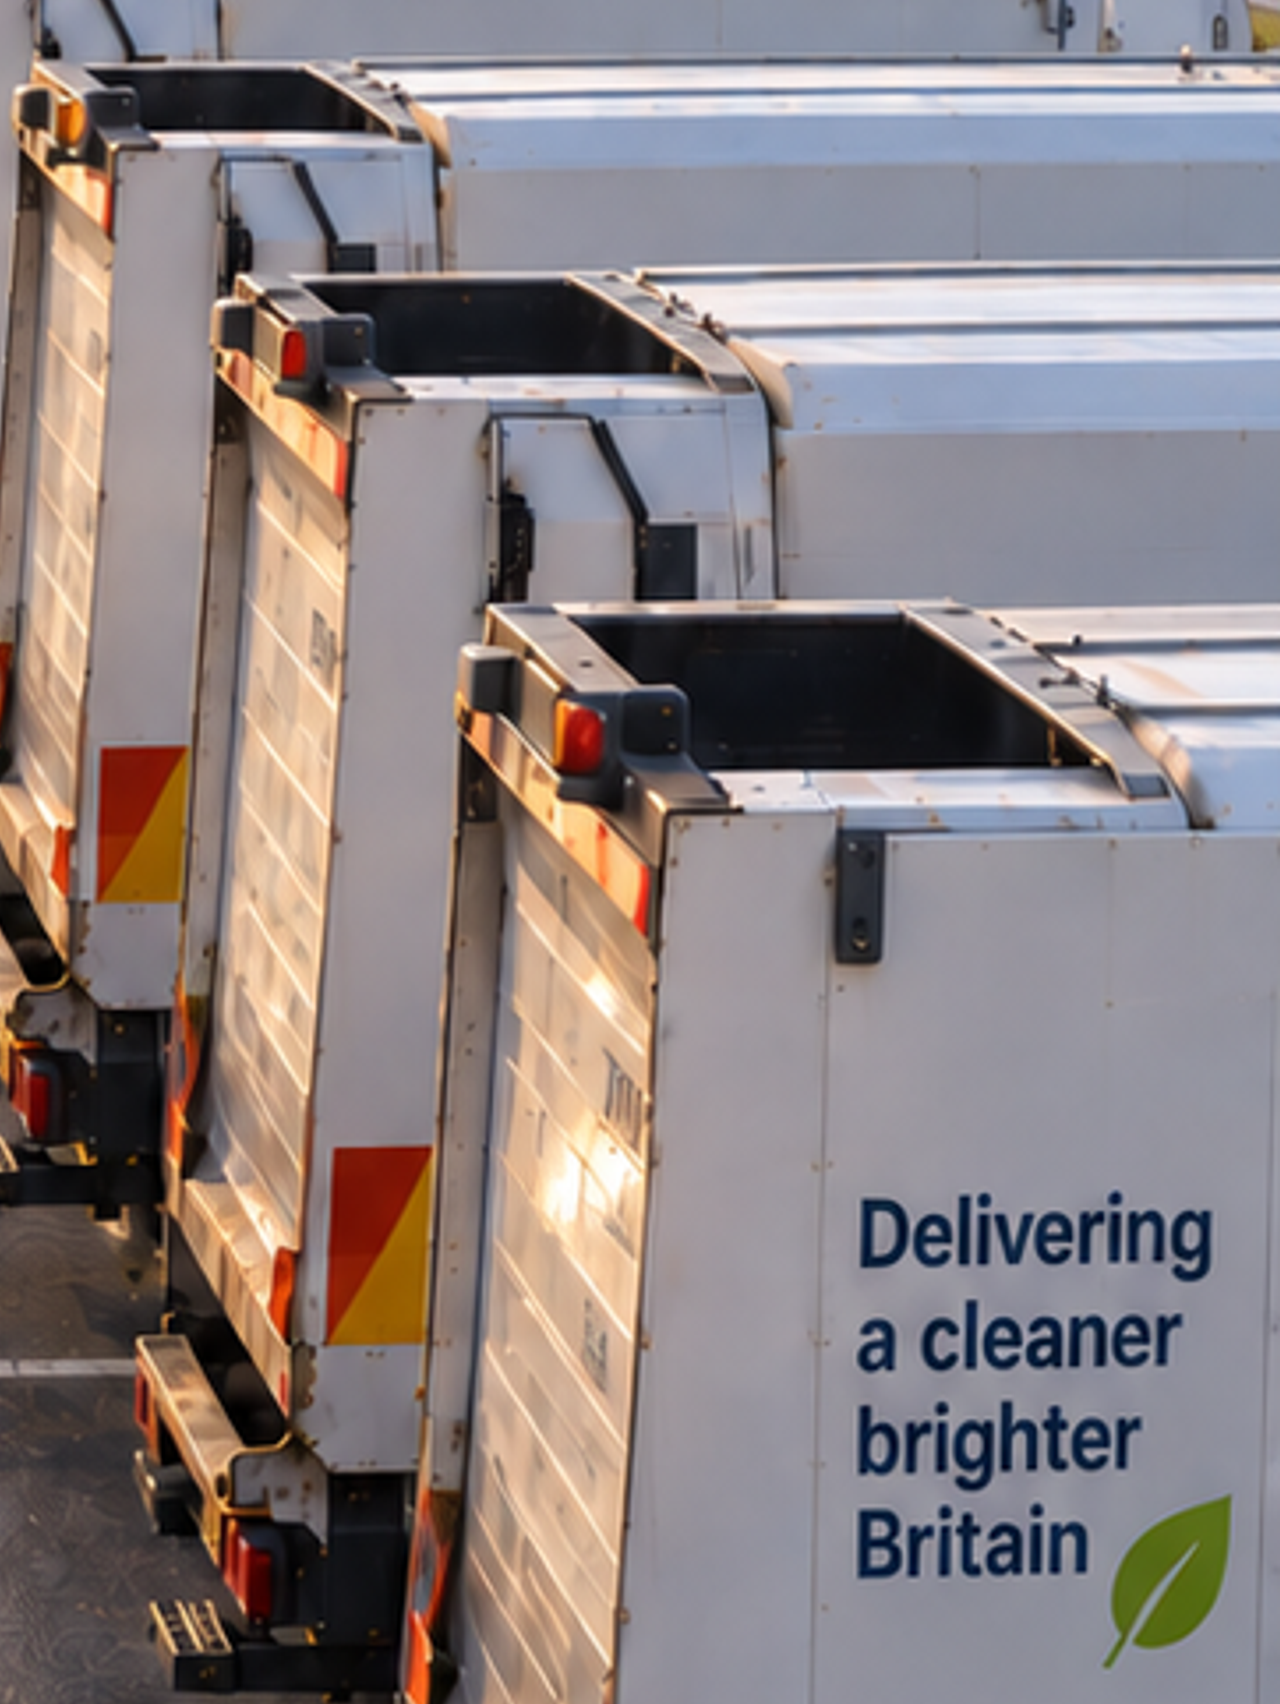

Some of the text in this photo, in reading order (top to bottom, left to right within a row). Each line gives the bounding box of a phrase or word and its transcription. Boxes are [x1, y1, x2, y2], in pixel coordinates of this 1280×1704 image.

[860, 1191, 1212, 1282] Delivering
[857, 1300, 1183, 1373] a cleaner
[858, 1401, 1142, 1492] brighter
[857, 1503, 1088, 1580] Britain
